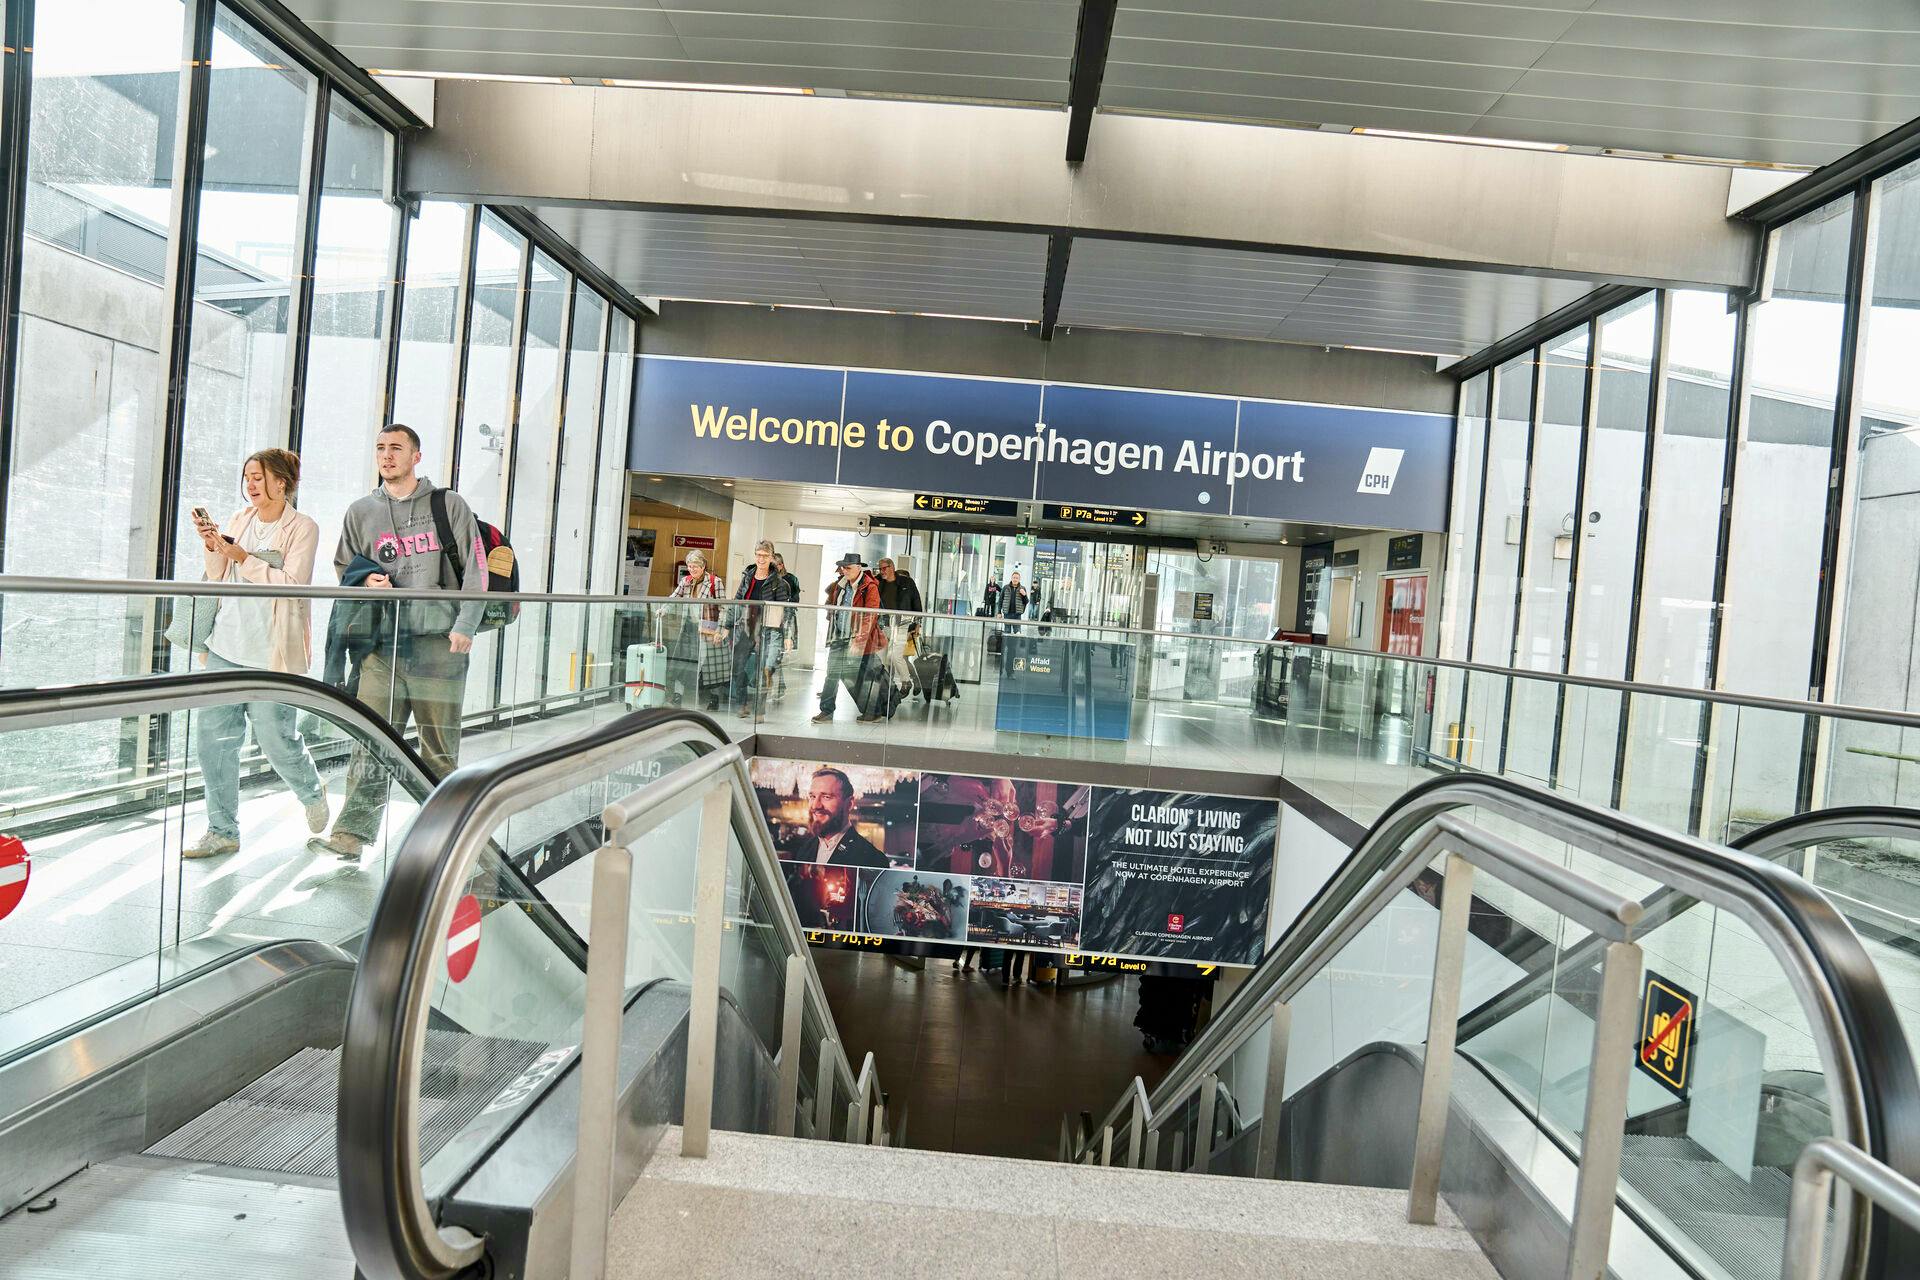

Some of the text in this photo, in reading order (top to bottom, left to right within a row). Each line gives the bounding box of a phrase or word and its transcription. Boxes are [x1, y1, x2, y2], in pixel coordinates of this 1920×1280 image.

[690, 404, 1305, 486] Welcome to Copenhagen Airport
[365, 473, 389, 489] CPH
[947, 499, 963, 509] P7a
[1075, 509, 1092, 519] P7a
[1030, 658, 1050, 666] Affald
[1030, 665, 1051, 673] Waste
[1197, 809, 1241, 830] LIVING
[1125, 827, 1244, 853] NOT JUST STAYING
[1111, 861, 1250, 879] THE ULTIMATE HOTEL EXPERIENCE
[1115, 870, 1245, 888] NOW AT COPENHAGEN AIRPORT
[1120, 961, 1140, 971] Level
[1140, 963, 1147, 971] 0
